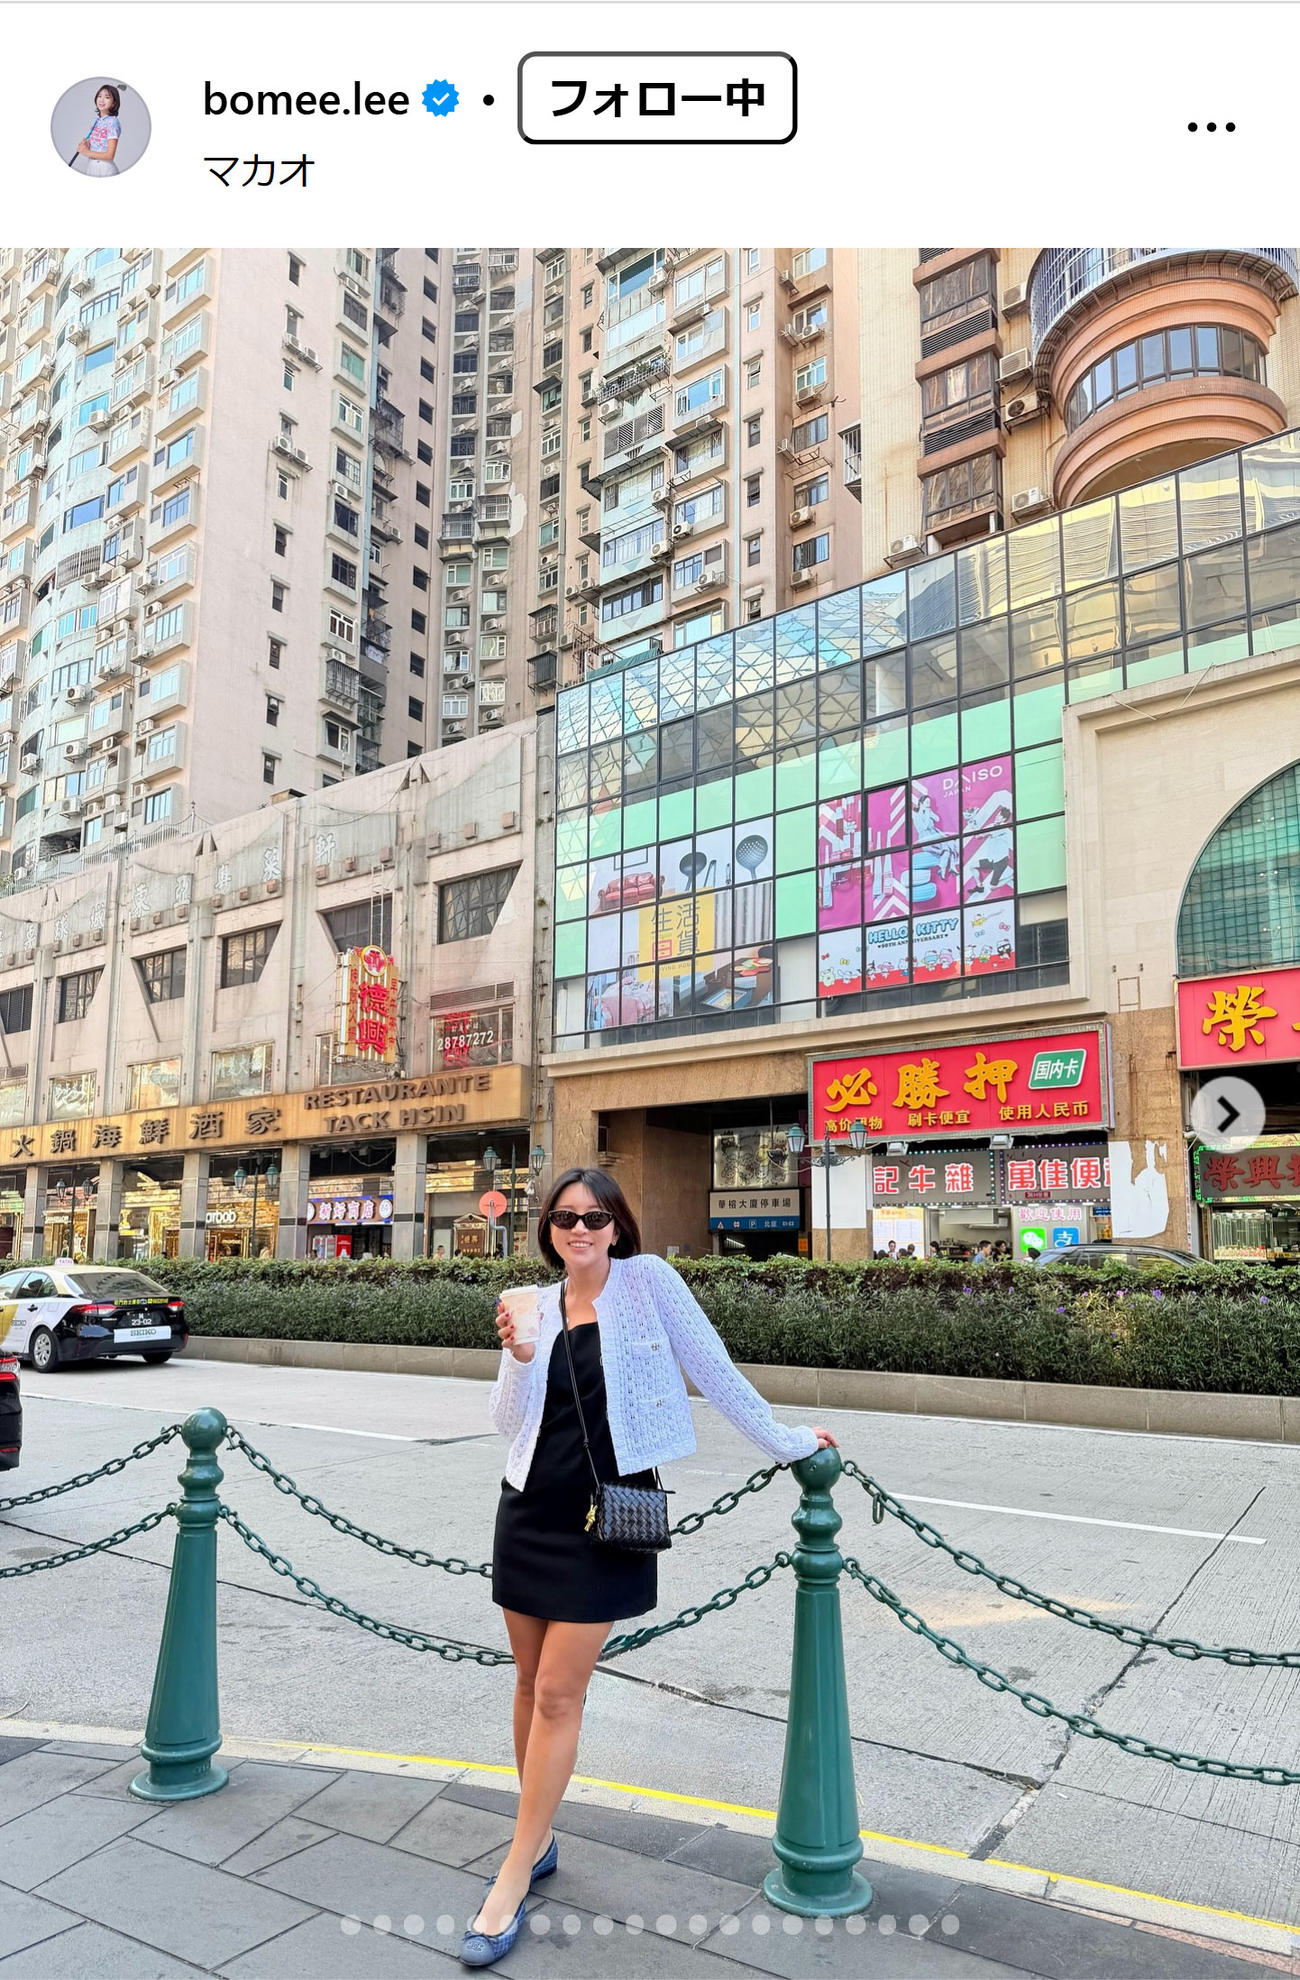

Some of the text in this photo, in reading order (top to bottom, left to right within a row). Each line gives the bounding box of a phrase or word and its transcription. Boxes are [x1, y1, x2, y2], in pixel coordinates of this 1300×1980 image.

[943, 765, 1003, 790] DAISO
[651, 900, 700, 934] 生活
[868, 917, 959, 944] HELLO KITTY
[897, 935, 943, 947] ANNIVERSARY
[357, 981, 389, 1055] 德興
[1202, 985, 1300, 1052] 榮
[437, 1030, 494, 1051] 28787272
[824, 1052, 1018, 1112] 必勝押
[1034, 1059, 1079, 1081] 国内卡
[304, 1073, 490, 1110] RESTAURANTE
[324, 1104, 464, 1133] TACK HSIN
[908, 1110, 970, 1127] 刷卡便宜
[999, 1101, 1089, 1121] 使用人民币
[10, 1107, 282, 1158] 火鍋海鮮酒家
[873, 1163, 973, 1194] 記牛雜
[1008, 1156, 1111, 1191] 萬佳便
[1018, 1206, 1083, 1221] 歡迎使用
[130, 1328, 157, 1337] SEIKO
